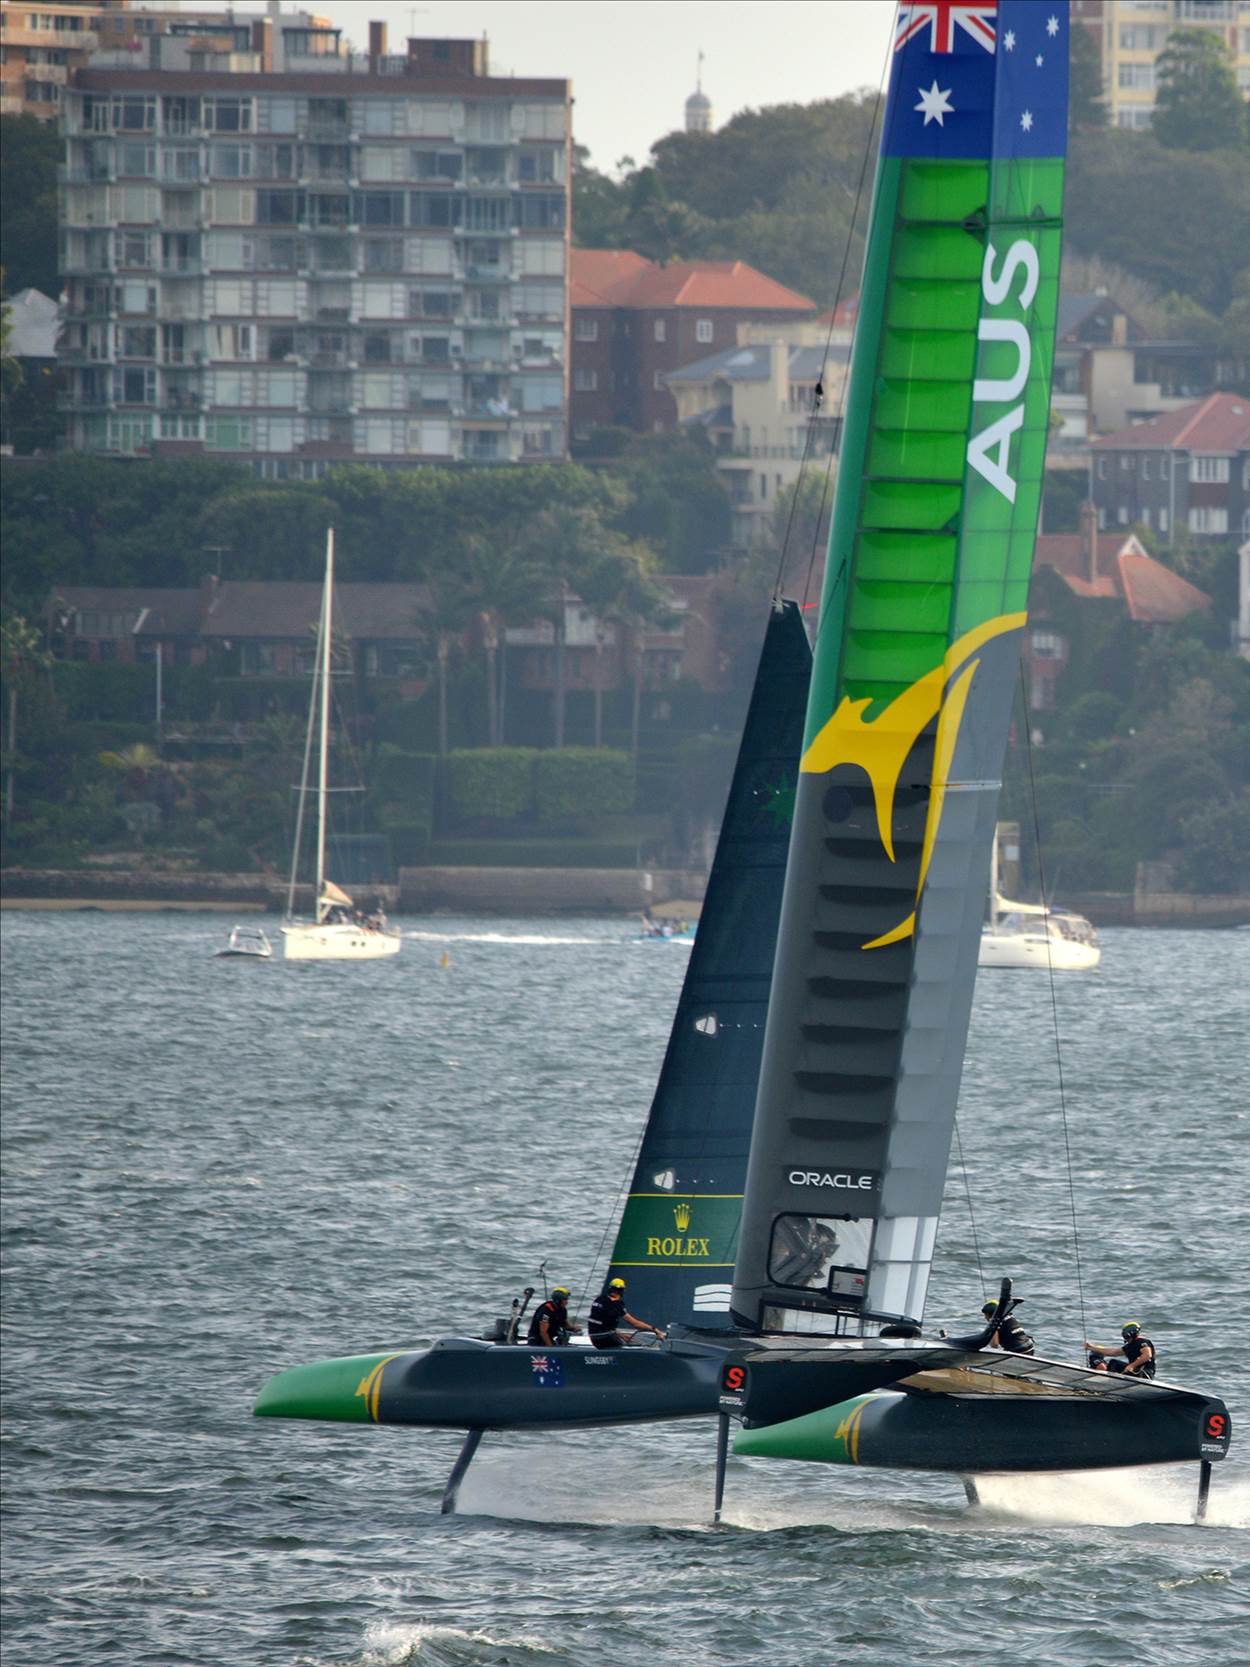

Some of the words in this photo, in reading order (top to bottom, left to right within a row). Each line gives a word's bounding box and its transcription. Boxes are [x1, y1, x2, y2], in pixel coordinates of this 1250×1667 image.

[967, 240, 1039, 504] AUS
[789, 1171, 872, 1190] ORACLE
[647, 1238, 710, 1256] ROLEX
[726, 1367, 745, 1389] S
[1207, 1415, 1226, 1436] S
